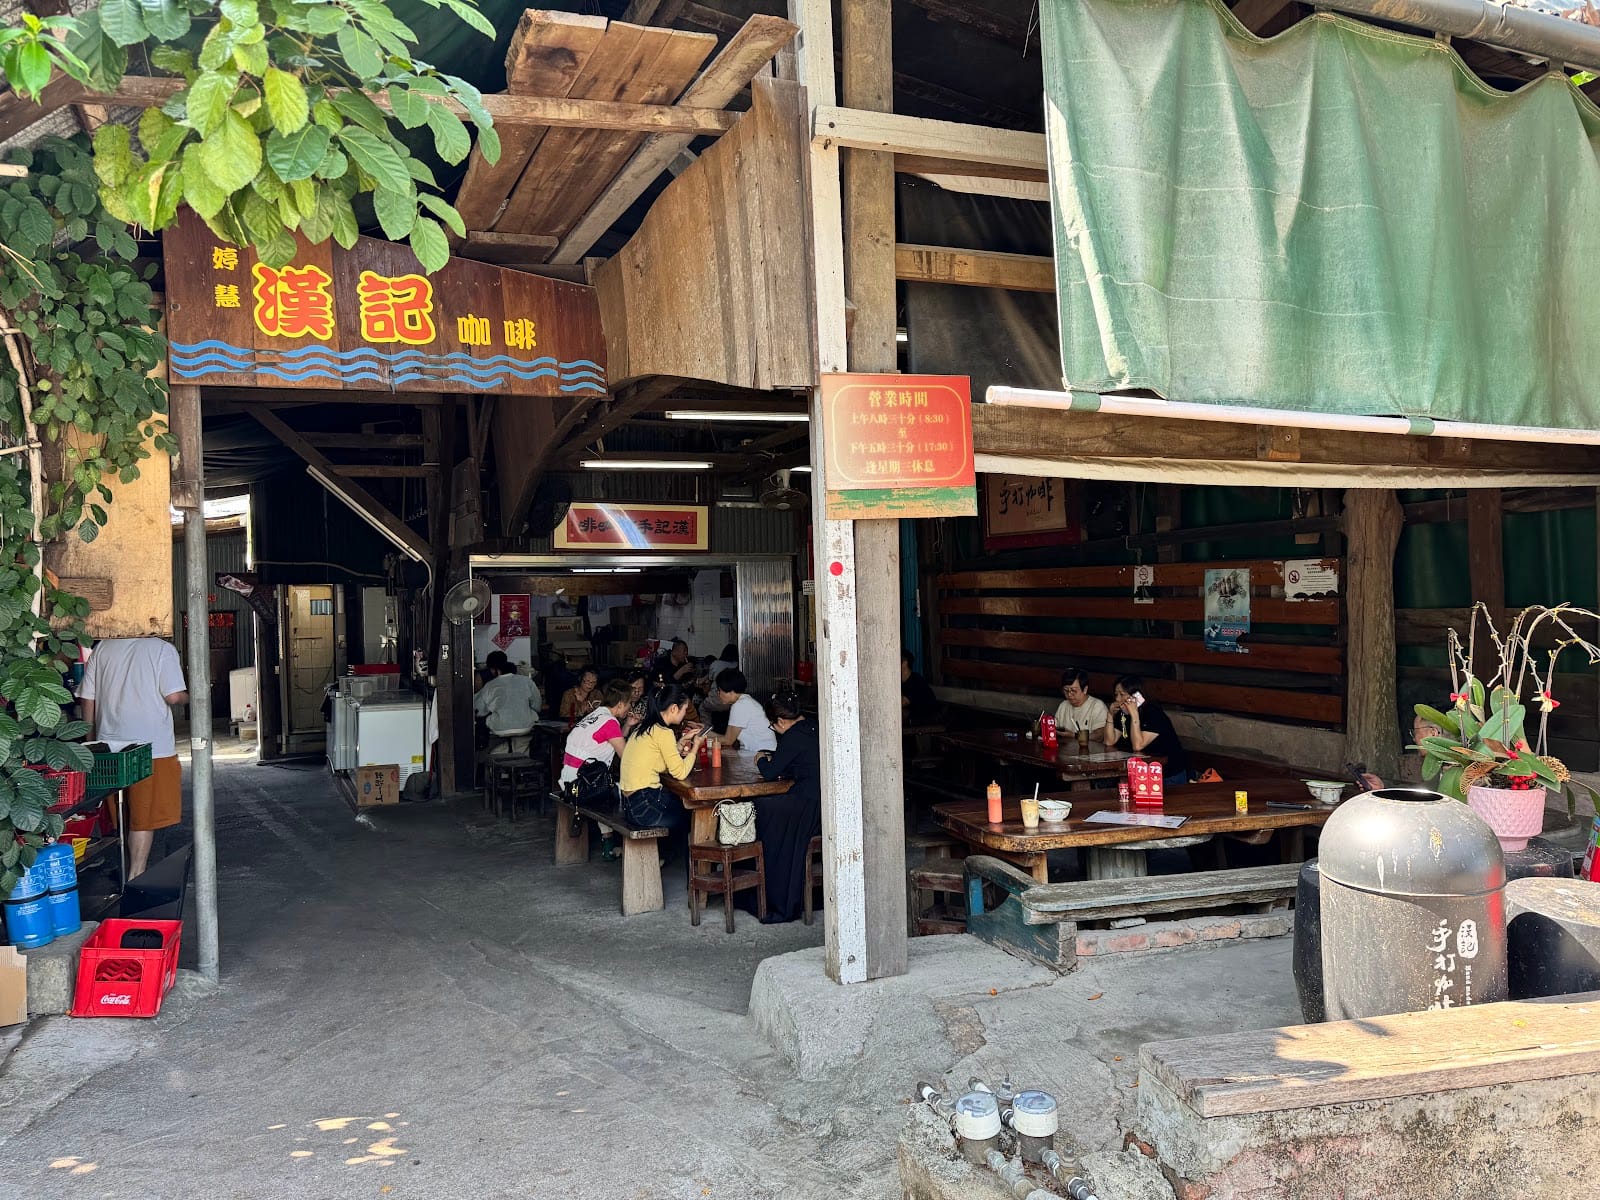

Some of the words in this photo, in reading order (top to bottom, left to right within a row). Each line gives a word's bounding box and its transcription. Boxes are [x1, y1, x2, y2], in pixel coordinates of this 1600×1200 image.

[212, 246, 241, 308] 婷慧
[252, 261, 437, 346] 漢記
[457, 313, 537, 351] 咖啡
[868, 390, 929, 408] 營業時間
[864, 459, 936, 475] 逢星期三休息
[1137, 765, 1148, 774] 71
[1150, 765, 1161, 774] 72
